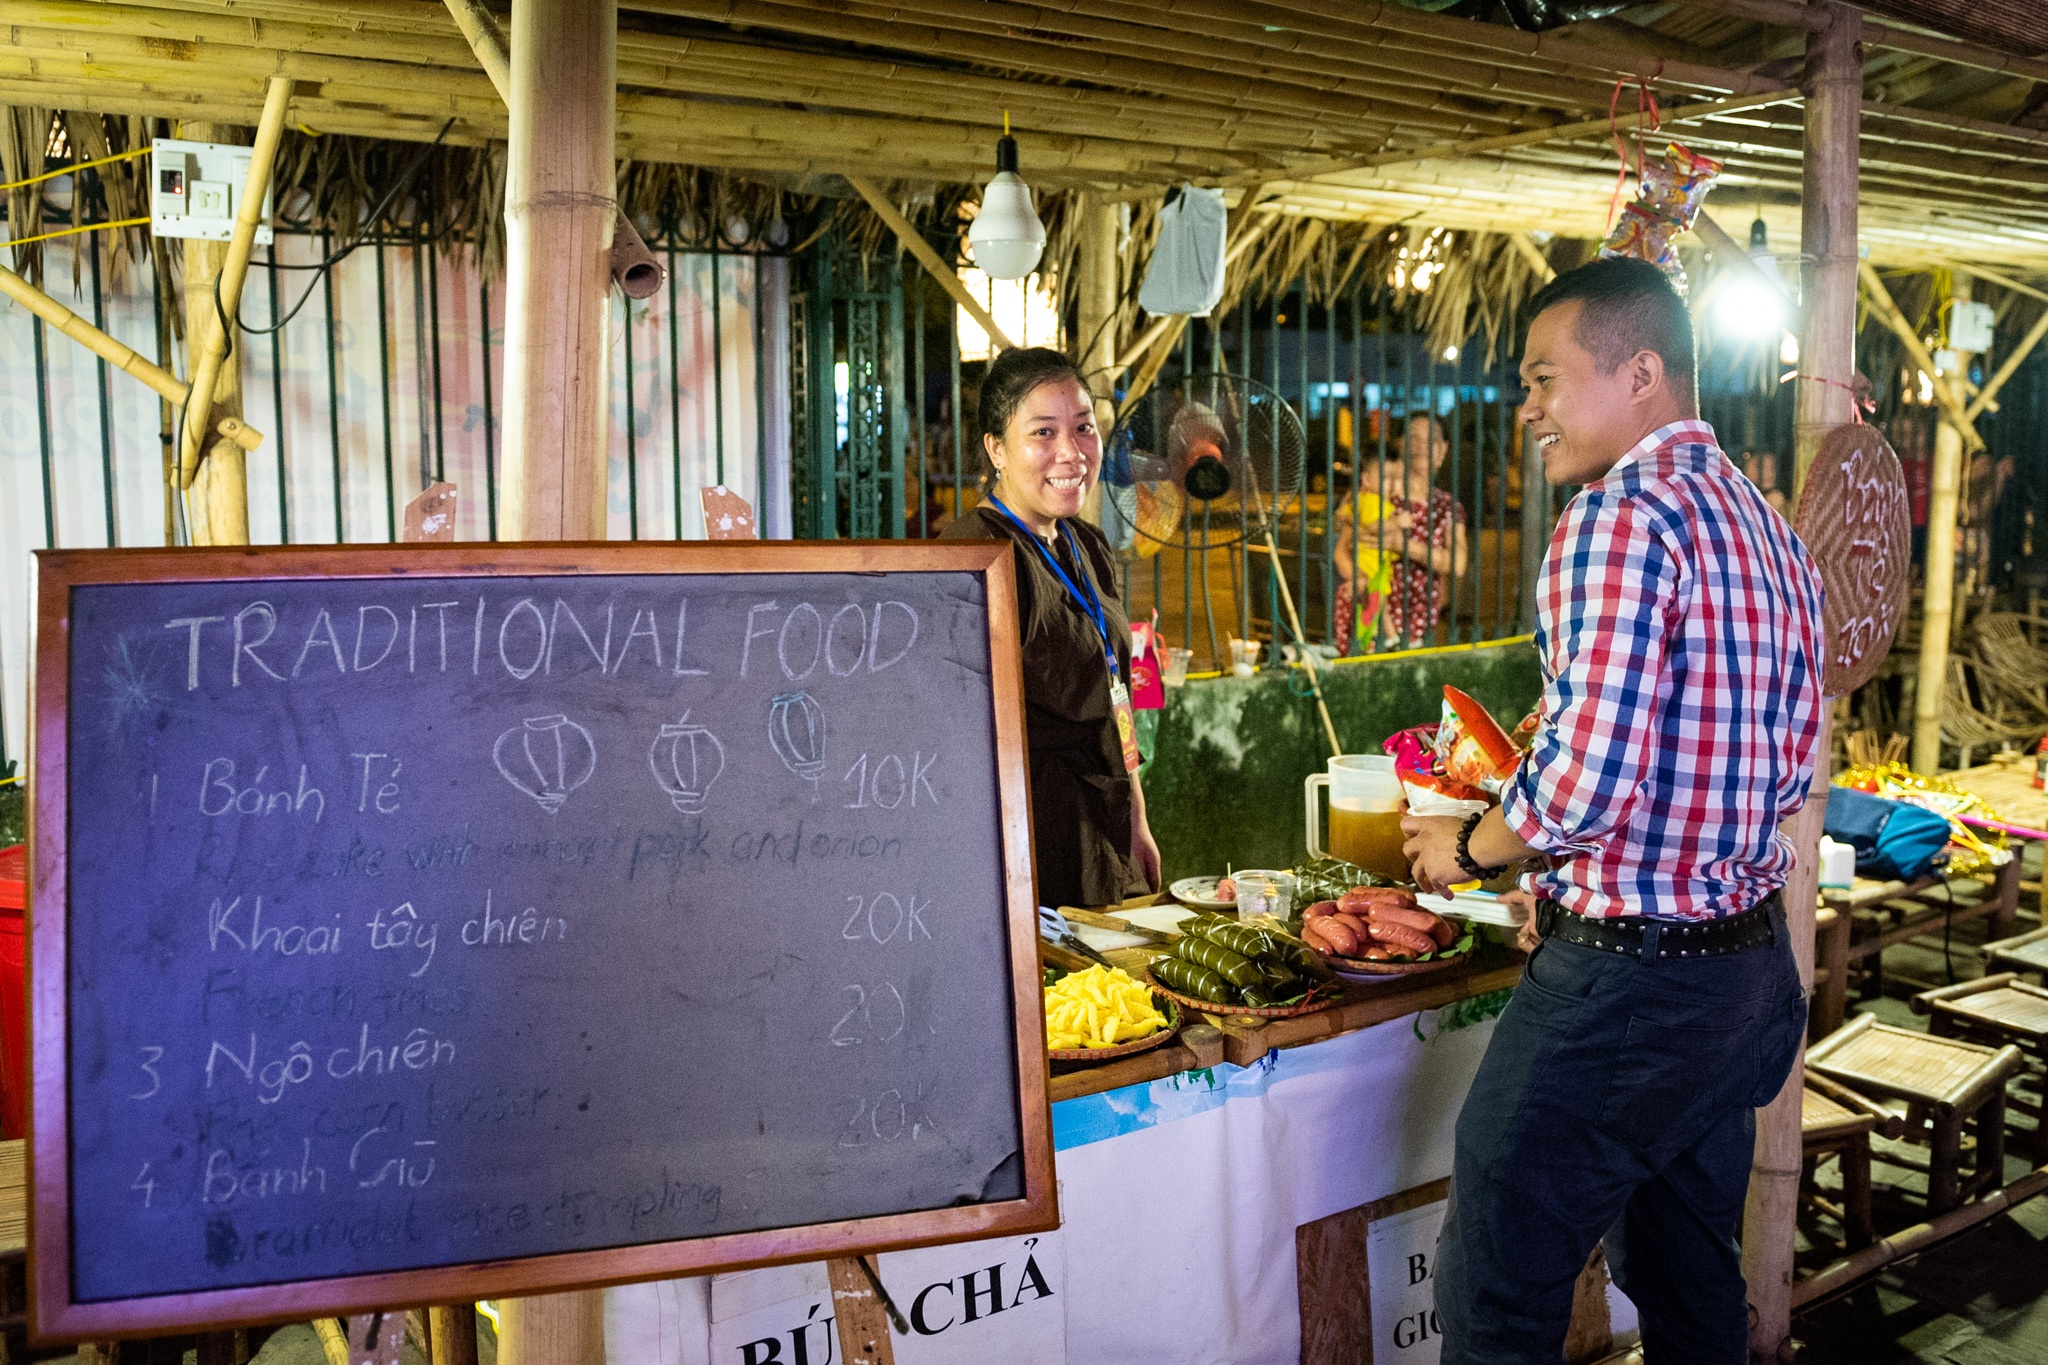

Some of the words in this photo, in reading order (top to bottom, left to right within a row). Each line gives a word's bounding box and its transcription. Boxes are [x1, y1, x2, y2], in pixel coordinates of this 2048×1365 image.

[164, 596, 710, 691] TRADITIONAL
[740, 599, 920, 682] FOOD
[199, 756, 325, 824] Bánh
[843, 751, 939, 810] 10K
[208, 895, 341, 956] Khoai
[366, 900, 438, 978] tây
[460, 888, 568, 946] chiên
[842, 891, 932, 945] 20K
[129, 1045, 165, 1101] 3
[205, 1032, 314, 1104] Ngô
[327, 1021, 457, 1079] chiên
[131, 1162, 156, 1209] 4
[736, 1302, 836, 1365] BÚ
[910, 1236, 1055, 1337] CHẢ
